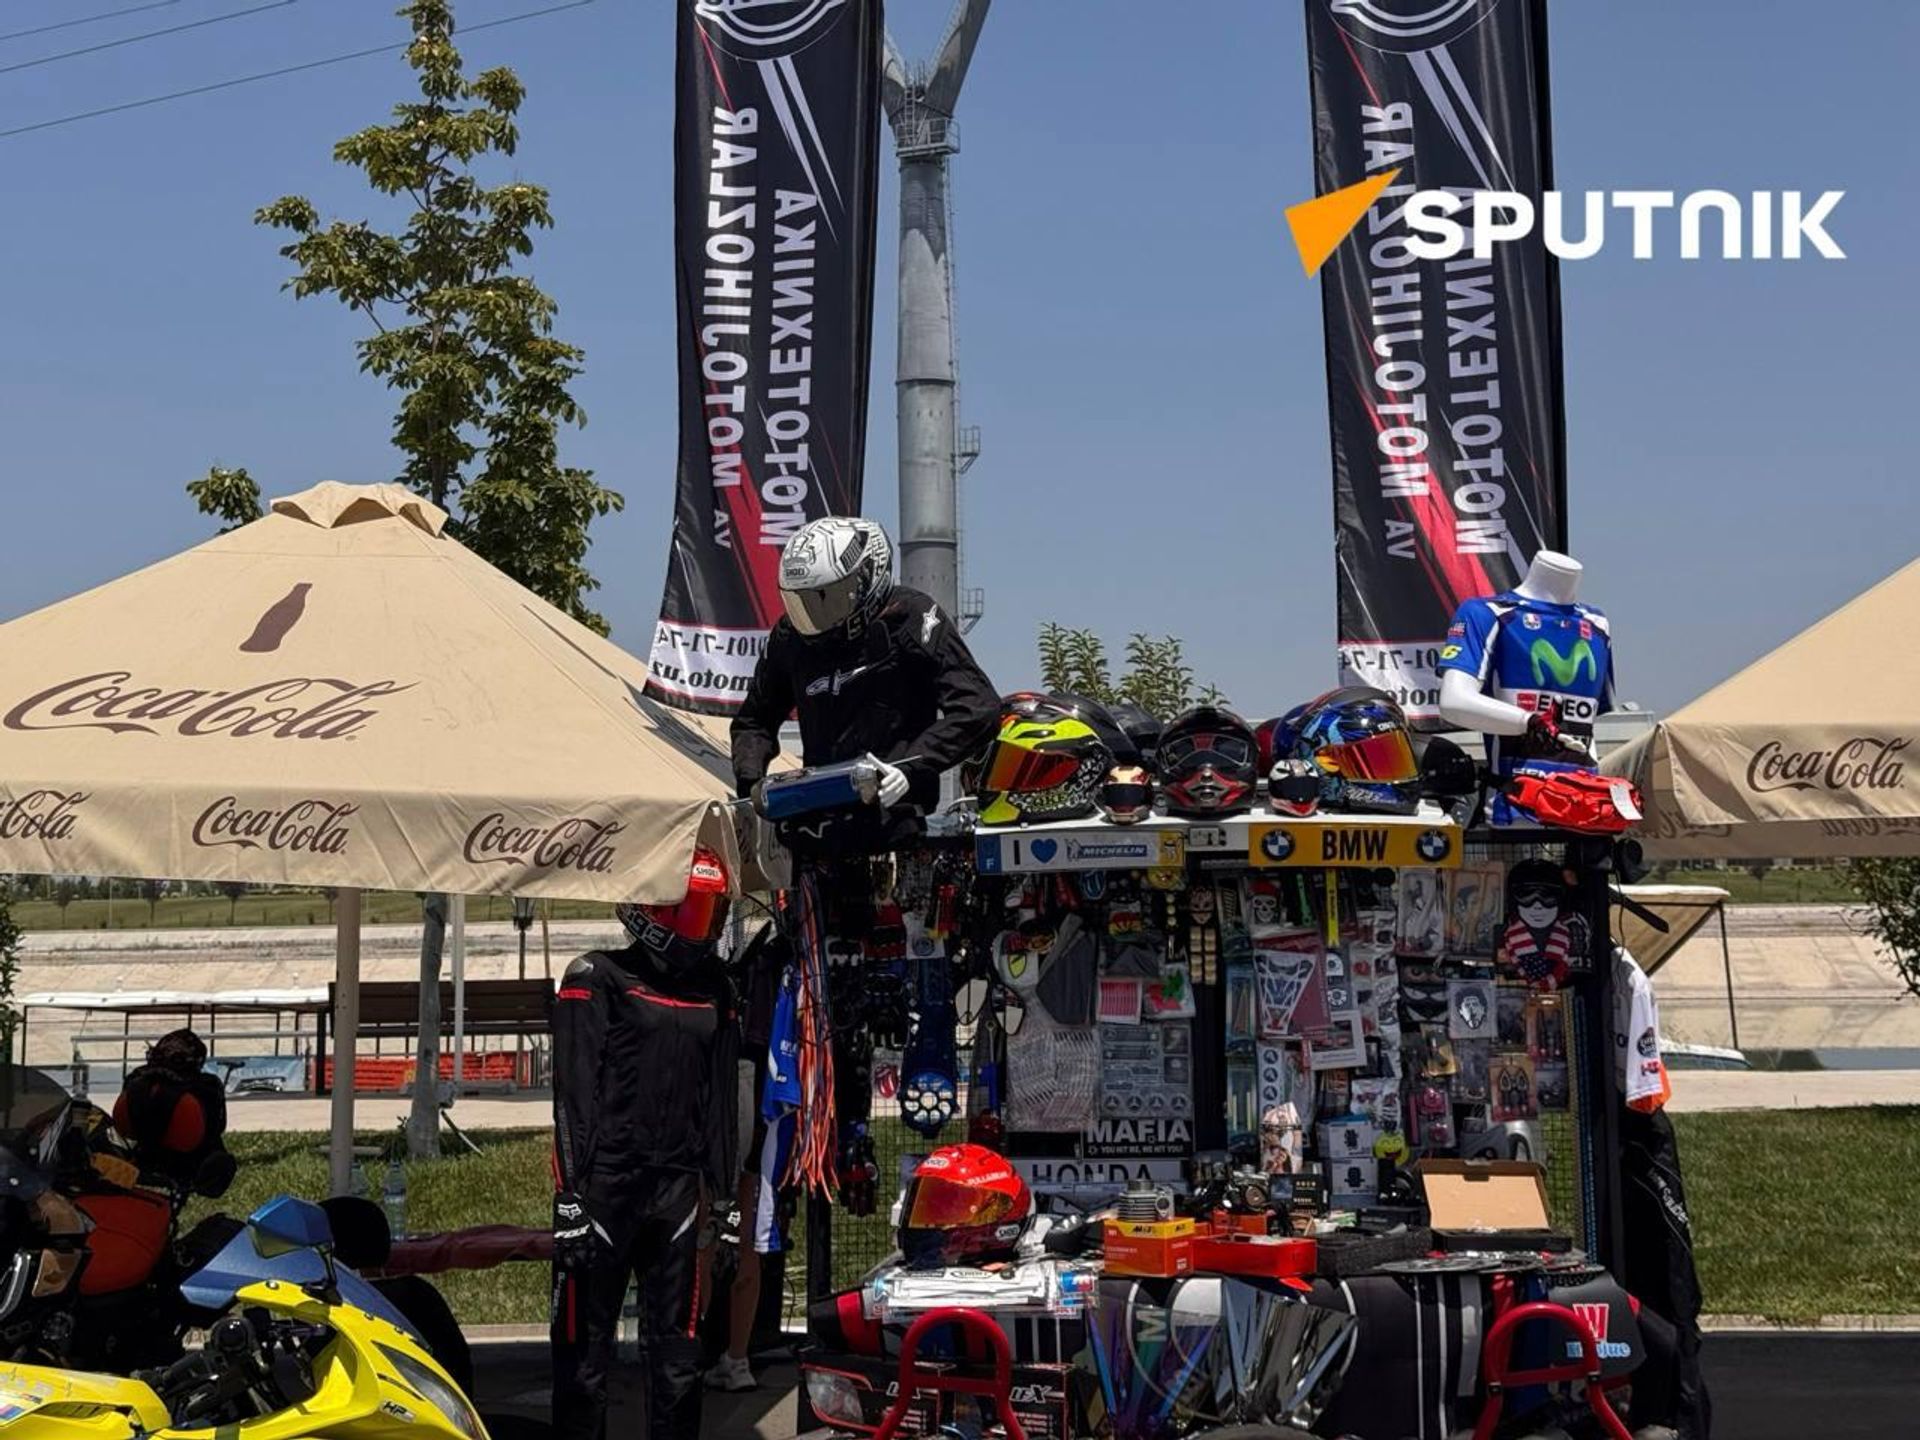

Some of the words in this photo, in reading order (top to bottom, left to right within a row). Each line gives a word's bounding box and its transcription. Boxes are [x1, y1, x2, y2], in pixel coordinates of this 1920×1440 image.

[3, 671, 421, 740] Coca-Cola
[1747, 737, 1914, 792] Coca-Cola
[192, 796, 360, 855] Coca-Cola
[463, 813, 630, 873] Coca-Cola
[1083, 845, 1146, 857] MICHELIN
[1322, 829, 1389, 861] BMW
[1087, 1119, 1191, 1143] MAFIA
